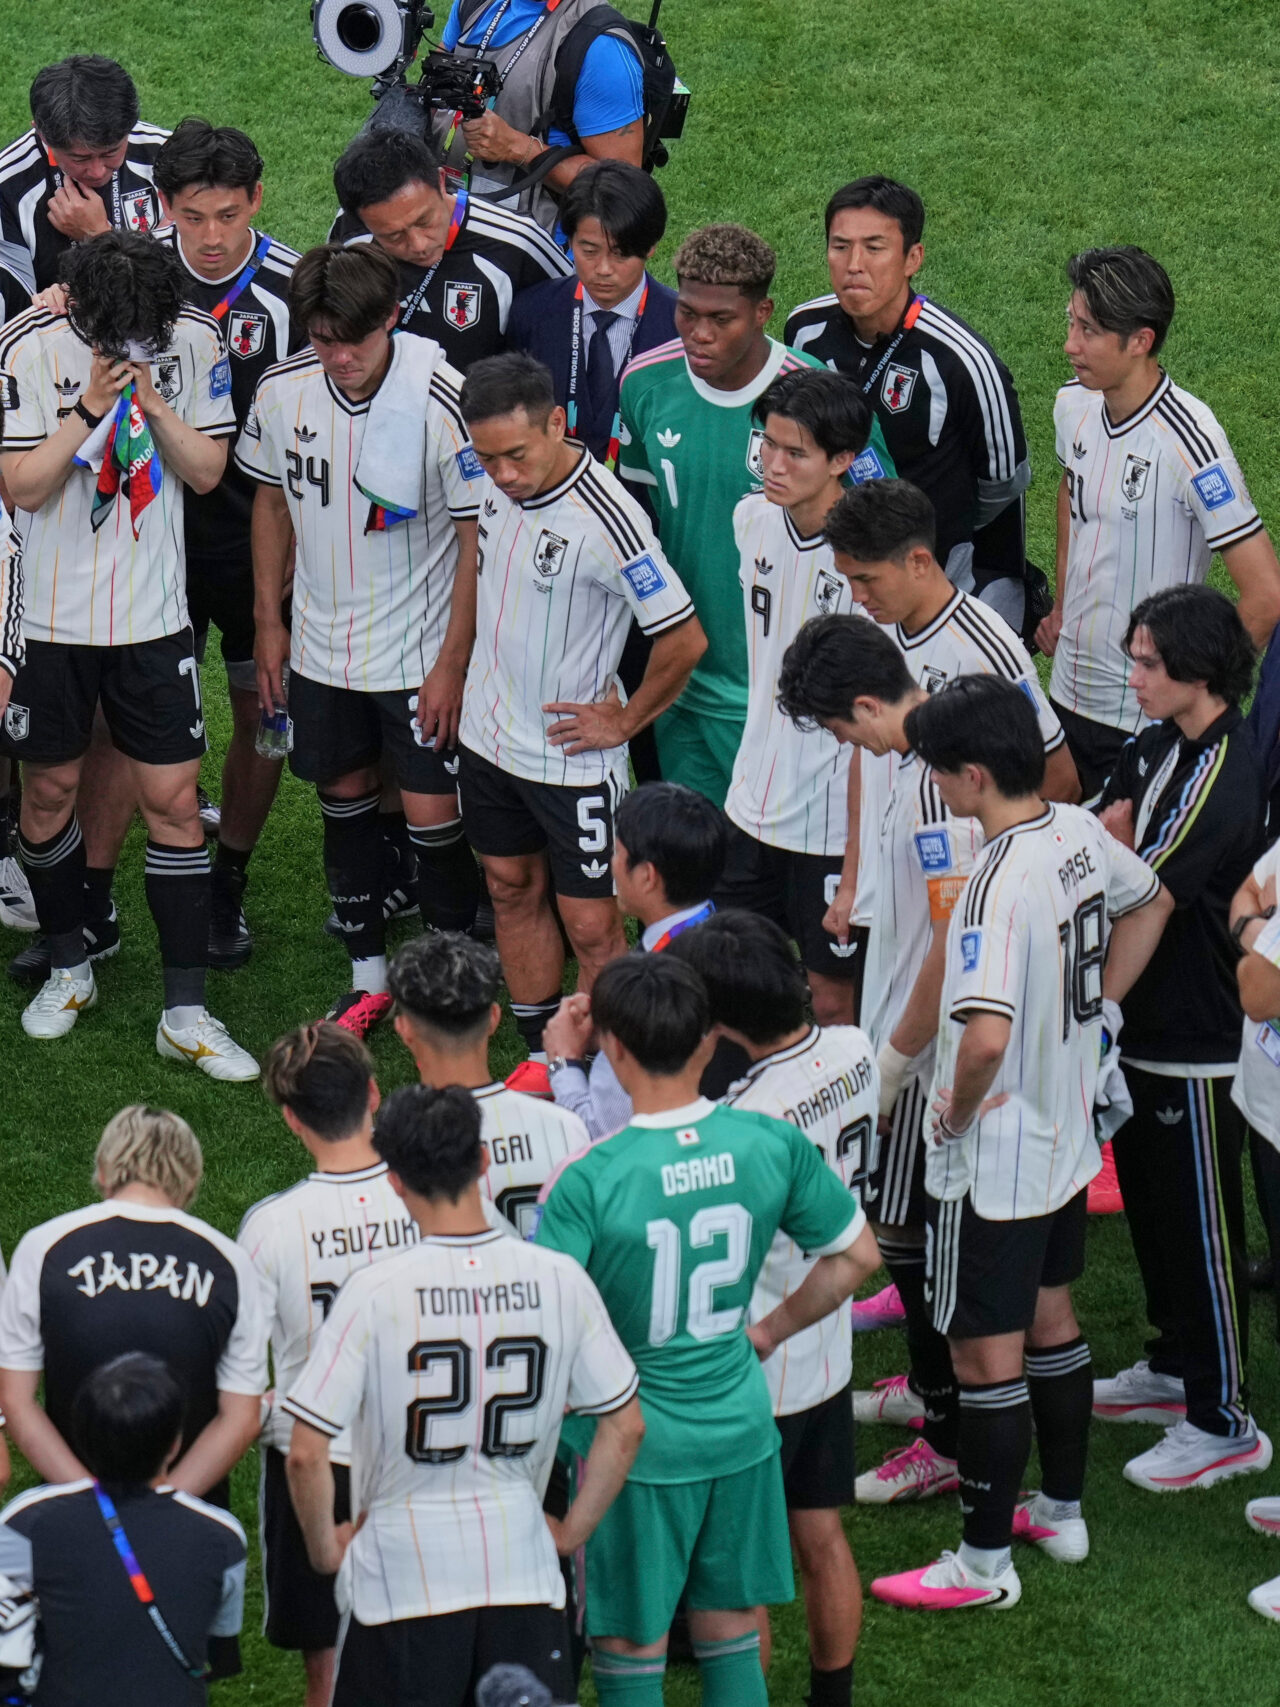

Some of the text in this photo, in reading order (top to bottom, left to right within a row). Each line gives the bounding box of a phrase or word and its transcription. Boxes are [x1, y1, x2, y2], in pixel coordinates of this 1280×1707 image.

[486, 12, 503, 36] WORLD
[480, 35, 490, 50] CUP
[503, 50, 521, 74] WORLD
[519, 38, 529, 52] CUP
[112, 182, 120, 209] WORLD
[128, 191, 147, 199] JAPAN
[113, 208, 121, 223] CUP
[413, 291, 423, 306] CUP
[419, 269, 436, 293] WORLD
[569, 306, 581, 395] FIFA WORLD CUP 2026
[891, 333, 904, 348] FIFA
[877, 347, 894, 370] WORLD
[160, 387, 174, 396] JFA
[869, 370, 880, 384] CUP
[134, 449, 158, 478] ORLD
[285, 448, 329, 507] 24
[660, 458, 678, 509] 1
[751, 585, 771, 638] 9
[178, 656, 201, 710] 7
[577, 796, 607, 853] 5
[1058, 891, 1104, 1044] 18
[661, 1152, 736, 1198] OSAKO
[312, 1217, 417, 1259] Y.SUZUK
[67, 1251, 214, 1308] JAPAN
[645, 1203, 753, 1347] 12
[415, 1282, 541, 1316] TOMIYASU
[405, 1336, 548, 1463] 22
